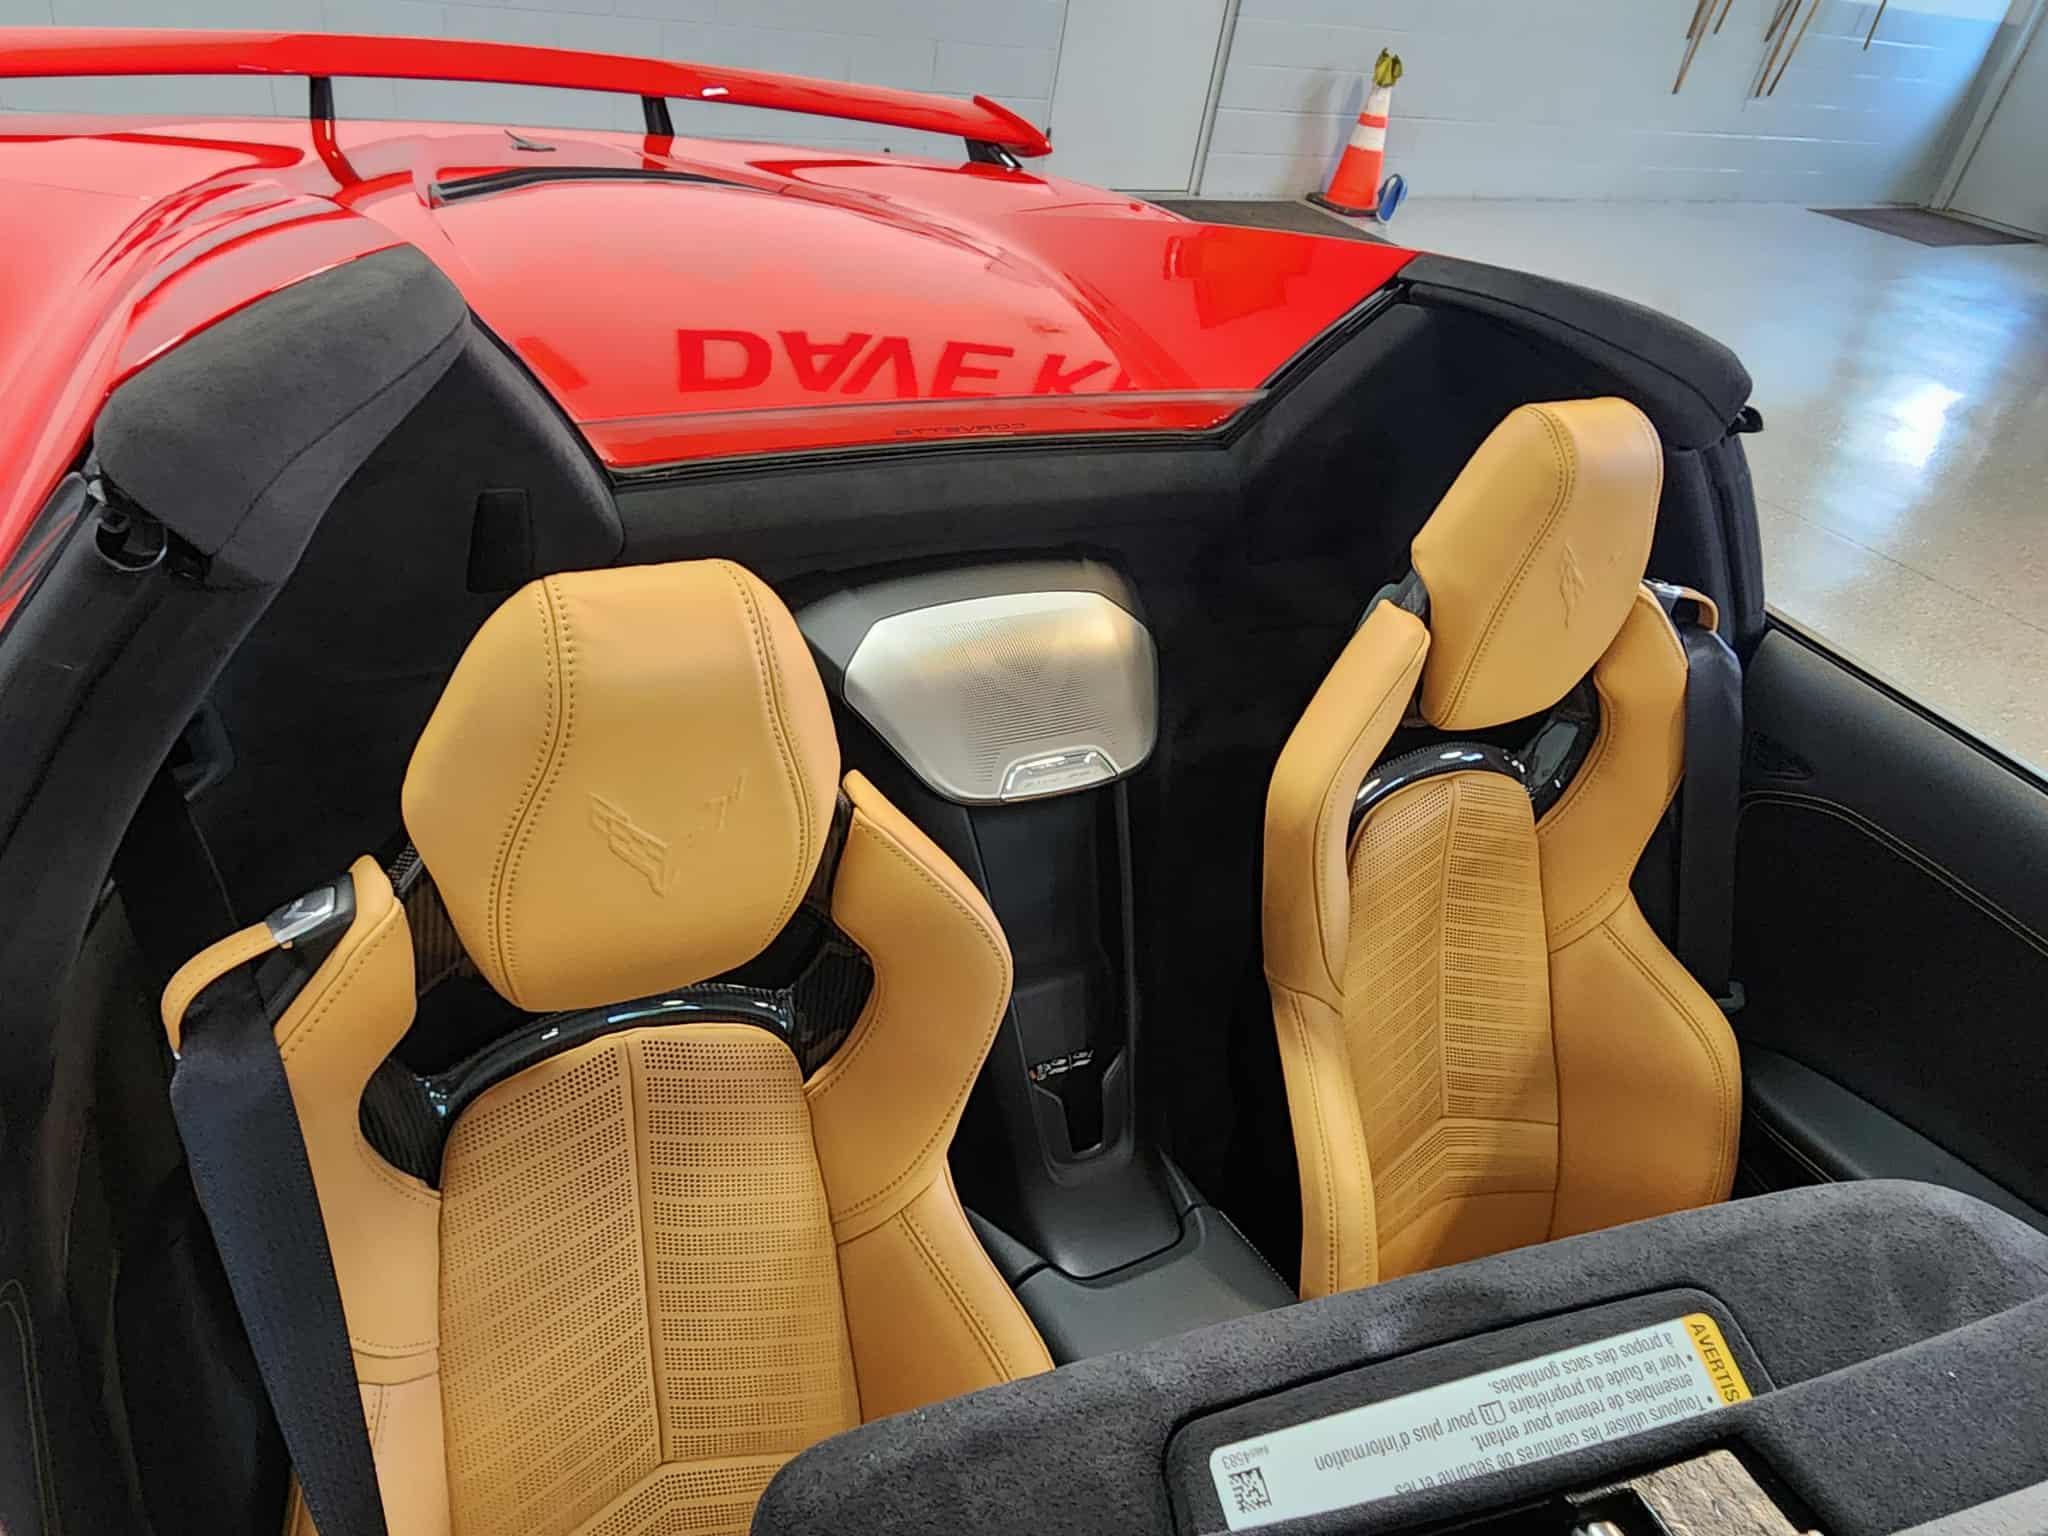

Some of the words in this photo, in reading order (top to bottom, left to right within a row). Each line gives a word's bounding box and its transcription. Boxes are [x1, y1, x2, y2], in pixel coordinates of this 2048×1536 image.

[1618, 1332, 1663, 1354] propos
[1664, 1333, 1674, 1347] à
[1563, 1355, 1593, 1373] sacs
[1594, 1347, 1618, 1363] des
[1659, 1353, 1686, 1371] Voir
[1488, 1361, 1560, 1395] gonflables.
[1608, 1365, 1643, 1386] Guide
[1645, 1359, 1658, 1376] le
[1587, 1375, 1604, 1392] du
[1626, 1374, 1692, 1403] ensembles
[1510, 1379, 1584, 1414] propriétaire
[1607, 1394, 1624, 1411] de
[1648, 1395, 1707, 1420] Toujours
[1447, 1408, 1478, 1431] pour
[1523, 1411, 1553, 1434] pour
[1556, 1399, 1605, 1424] retenue
[1604, 1408, 1648, 1434] utiliser
[1412, 1418, 1443, 1440] plus
[1472, 1425, 1518, 1451] enfant.
[1583, 1425, 1604, 1445] les
[1315, 1432, 1410, 1470] d'information
[1517, 1433, 1579, 1462] ceintures
[1497, 1450, 1516, 1468] de
